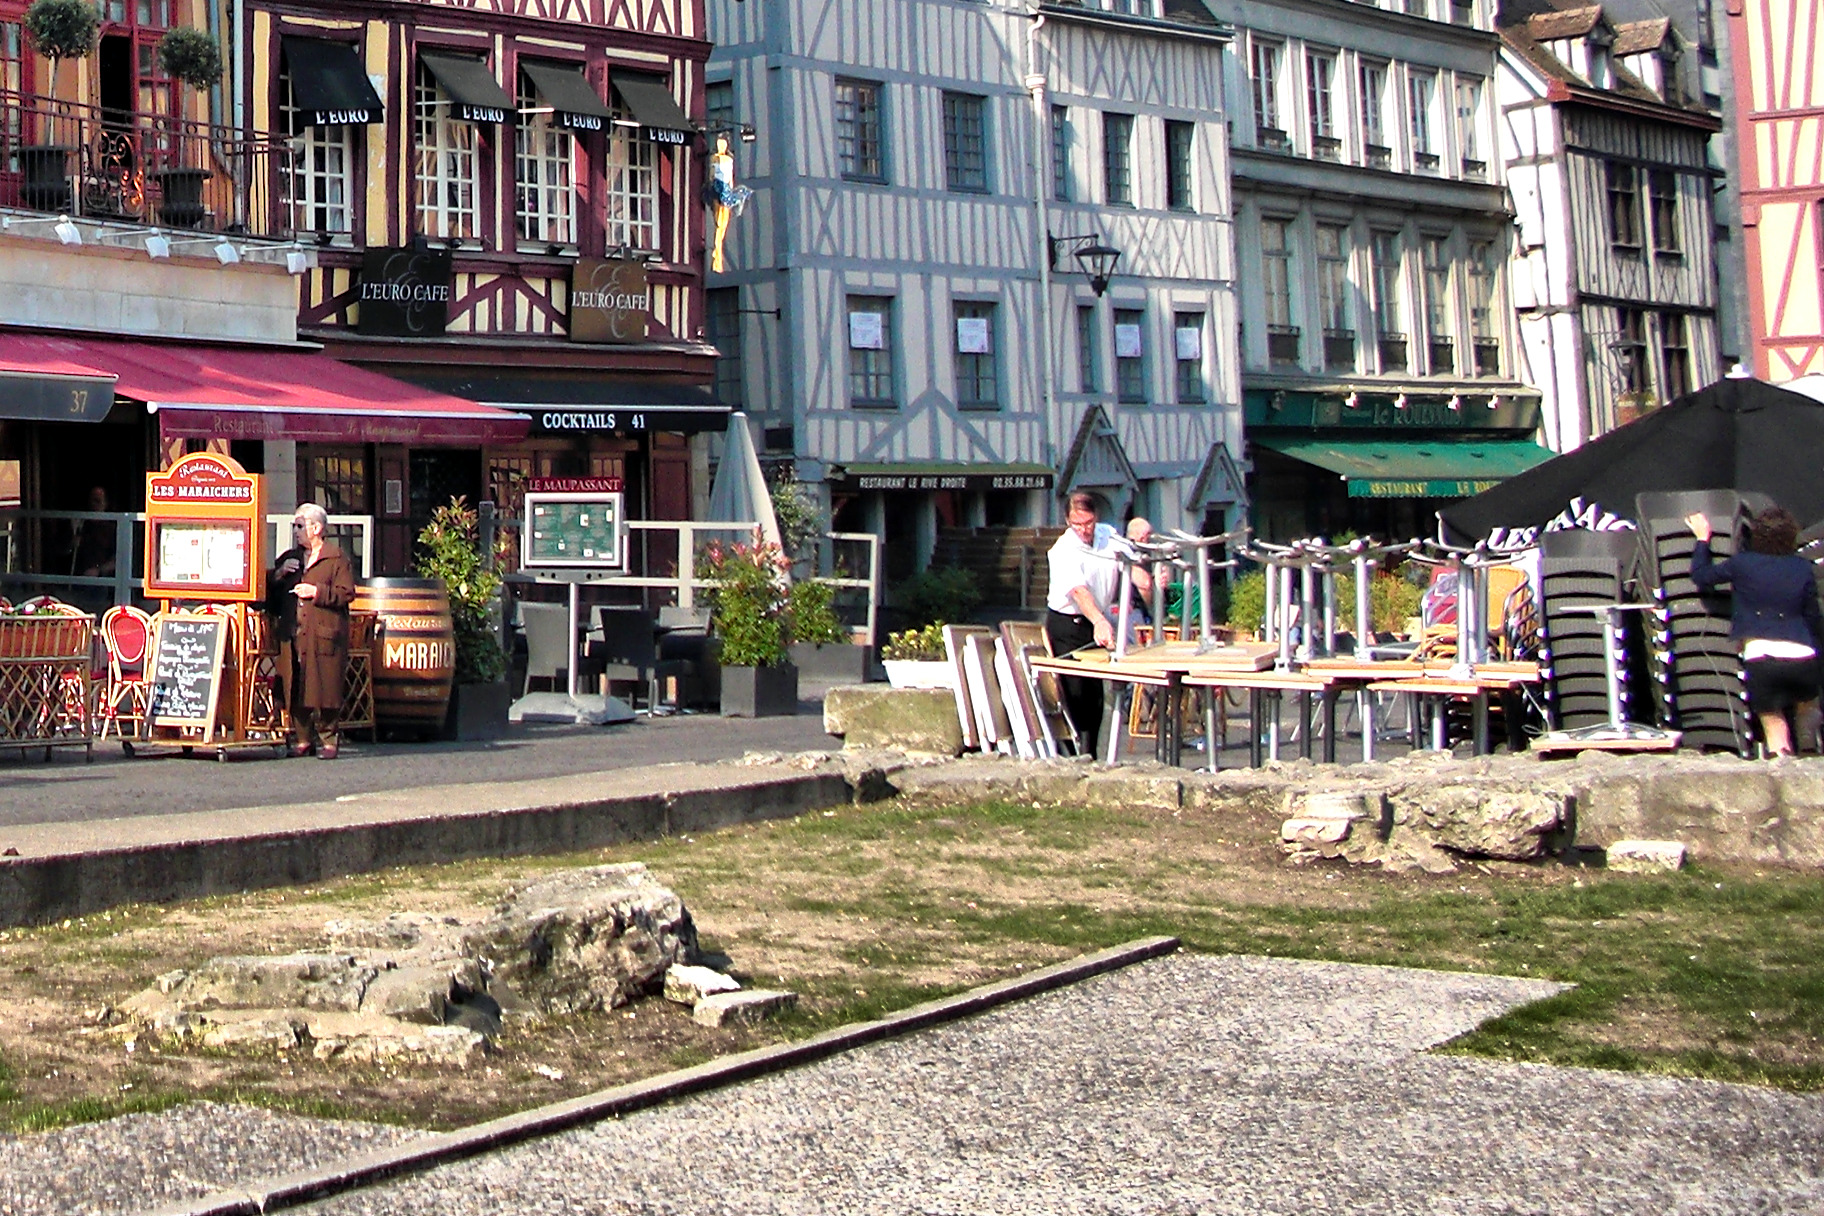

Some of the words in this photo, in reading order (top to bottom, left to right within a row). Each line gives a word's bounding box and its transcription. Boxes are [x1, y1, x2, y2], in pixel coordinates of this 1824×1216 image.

[361, 283, 411, 301] L'EURO
[572, 290, 614, 309] L'EURO
[70, 390, 89, 414] 37
[542, 413, 616, 429] COCKTAILS
[631, 414, 645, 429] 41
[179, 462, 229, 479] Restaurant
[152, 485, 175, 497] LES
[178, 485, 250, 498] MARAICHERS
[529, 479, 541, 490] LE
[543, 479, 620, 491] MAUPASSANT
[1486, 526, 1541, 550] LES
[386, 642, 452, 669] MARAIC
